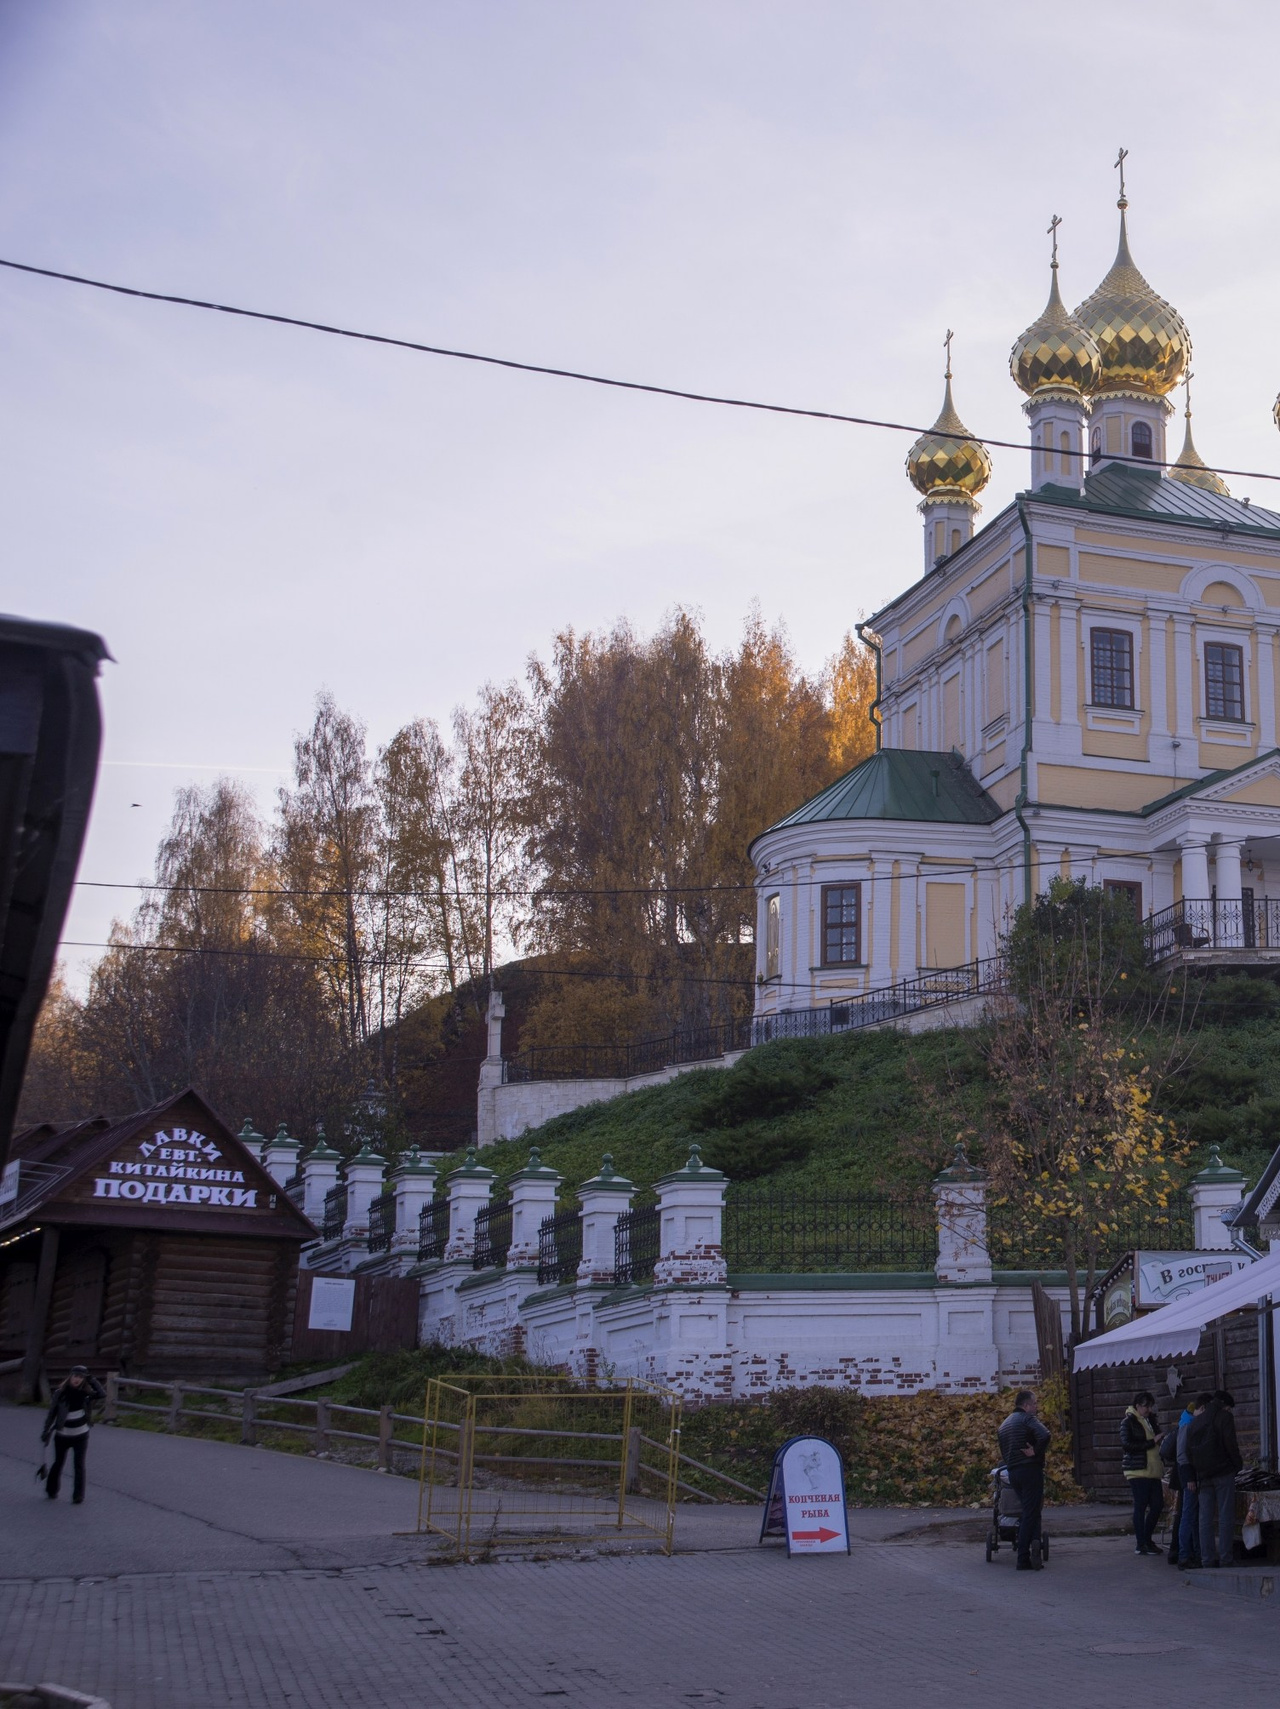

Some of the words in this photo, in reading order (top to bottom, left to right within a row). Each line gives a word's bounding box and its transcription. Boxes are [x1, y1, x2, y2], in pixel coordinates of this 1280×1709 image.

[139, 1128, 222, 1163] ЛАВКИ
[159, 1148, 201, 1163] ЕВТ.
[109, 1160, 245, 1183] КИТАЙКИНА
[93, 1178, 258, 1208] ПОДАРКИ
[1160, 1269, 1173, 1285] В
[788, 1494, 840, 1503] КОПЧЕНАЯ
[801, 1509, 830, 1518] РЫБА
